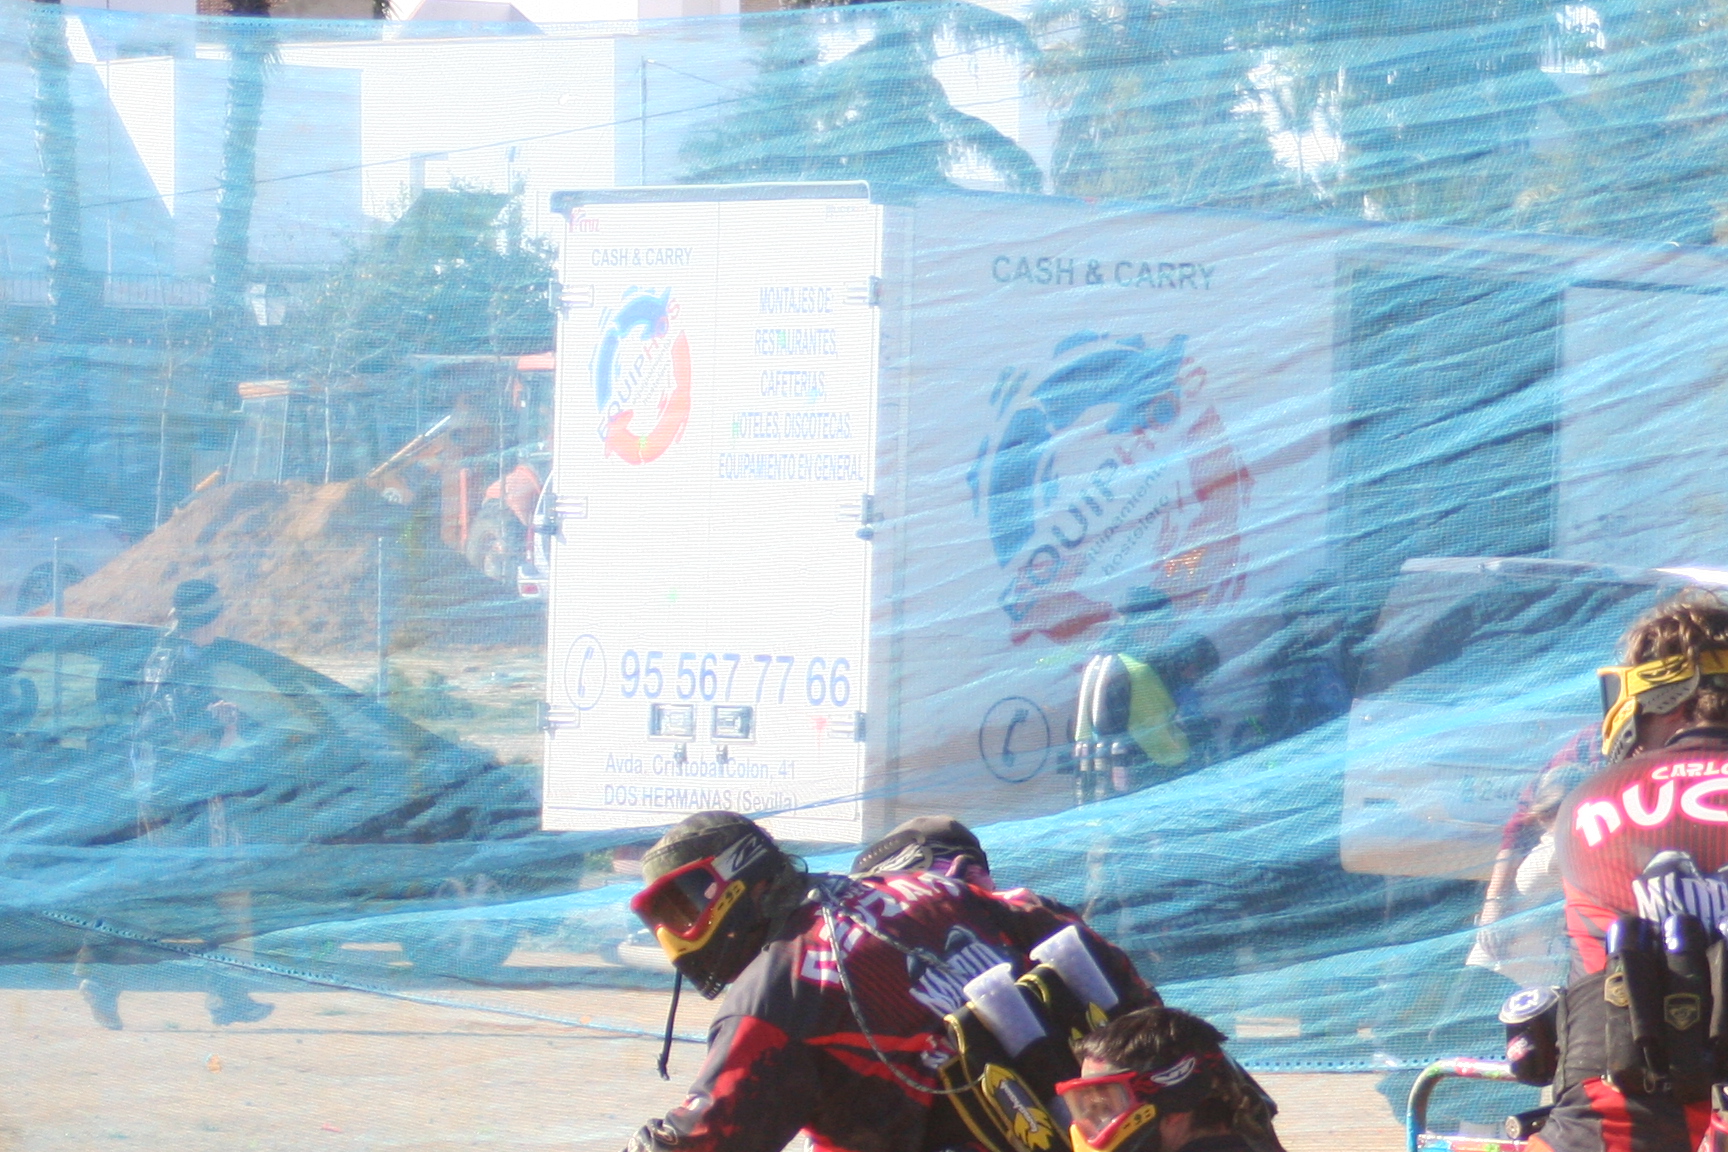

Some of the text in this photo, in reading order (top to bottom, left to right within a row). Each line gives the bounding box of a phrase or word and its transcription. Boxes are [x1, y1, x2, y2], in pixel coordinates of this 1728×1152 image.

[591, 246, 693, 267] CASH & CARRY
[991, 255, 1215, 291] CASH & CARRY
[718, 452, 796, 481] EQUIPAMIENTO
[814, 453, 865, 481] GENERAL
[621, 650, 851, 707] 95 567 77 66
[778, 760, 796, 780] 41
[604, 784, 638, 806] DOS
[642, 786, 733, 811] HERMANAS
